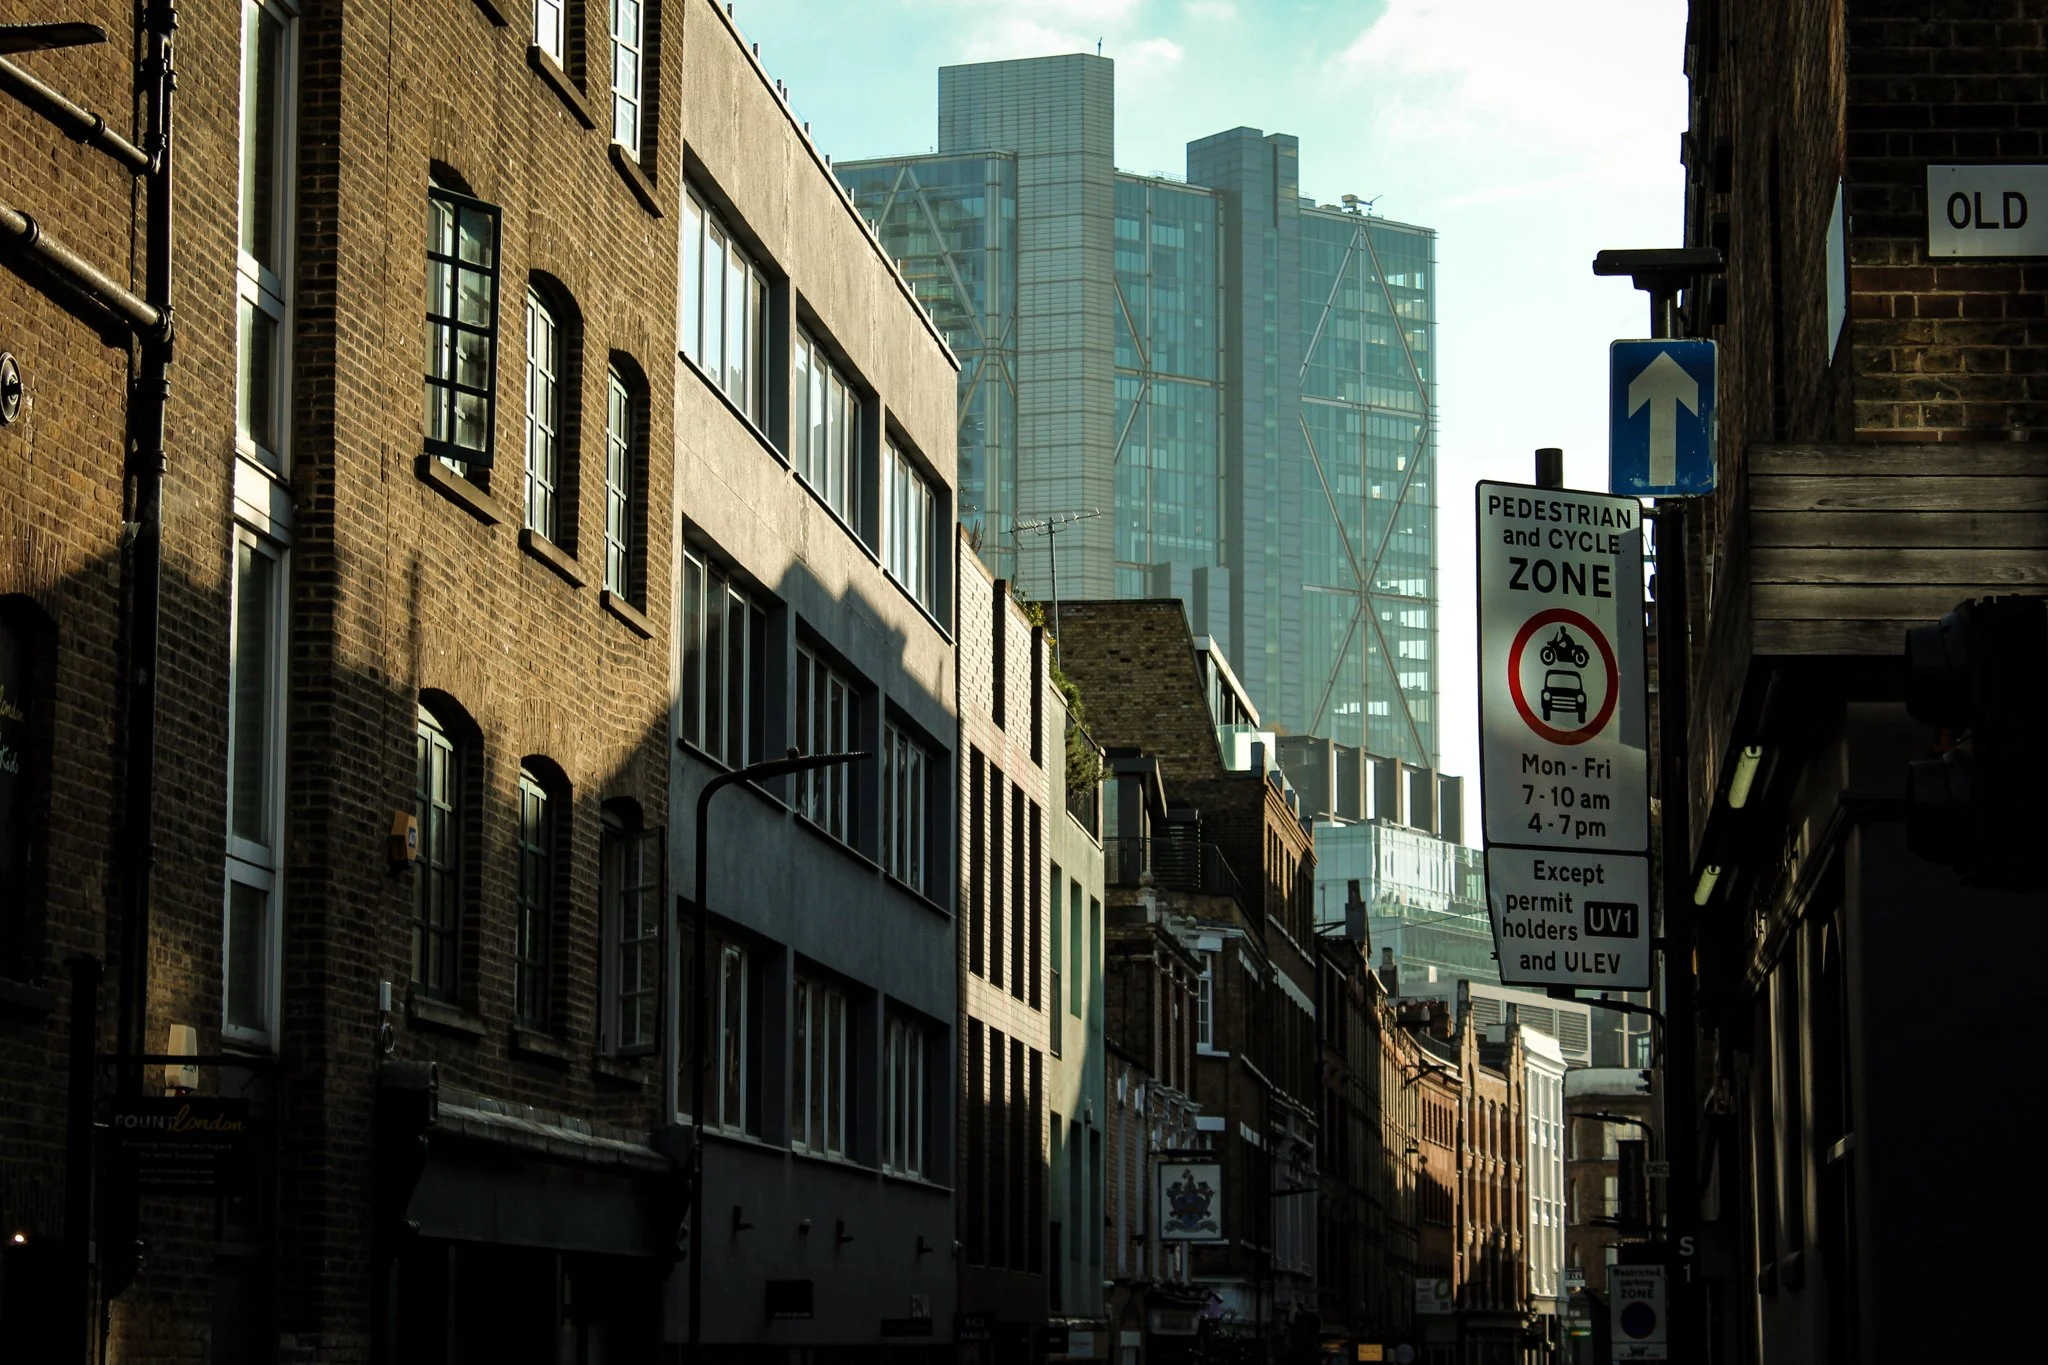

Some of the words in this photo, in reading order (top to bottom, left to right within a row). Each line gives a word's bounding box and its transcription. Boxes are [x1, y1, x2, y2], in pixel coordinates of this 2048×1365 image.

[1947, 191, 2028, 229] OLD
[1488, 495, 1632, 529] PEDESTRIAN
[1503, 527, 1540, 547] and
[1549, 529, 1621, 555] CYCLE
[1509, 557, 1612, 598] ZONE
[1522, 753, 1566, 776] Mon
[1585, 758, 1611, 779] Fri
[1580, 792, 1610, 810] am
[1576, 820, 1606, 839] pm
[1533, 860, 1604, 886] Except
[1506, 892, 1573, 914] permit
[1502, 917, 1578, 941] holders
[1589, 908, 1632, 934] UV1
[1520, 951, 1556, 971] and
[1564, 952, 1621, 974] ULEV
[1621, 1289, 1654, 1299] ZONE
